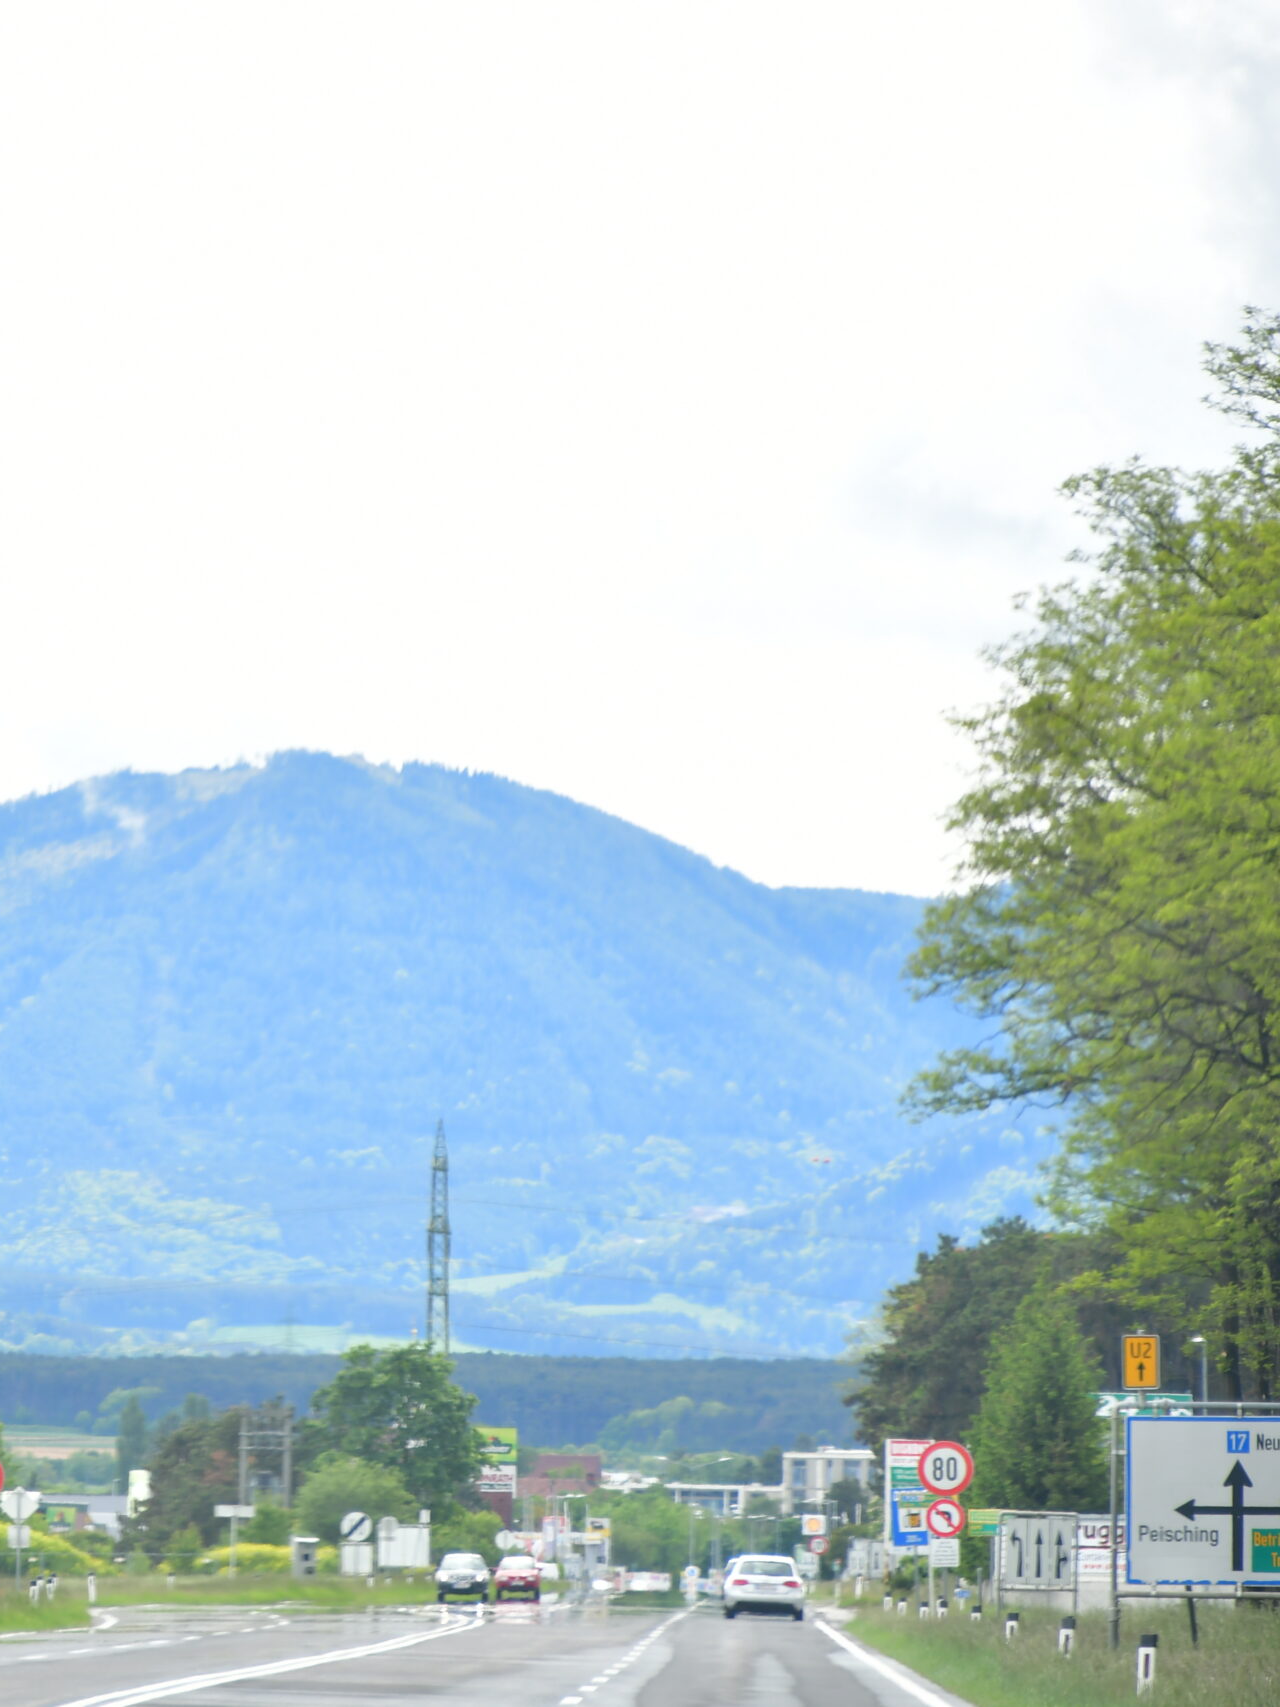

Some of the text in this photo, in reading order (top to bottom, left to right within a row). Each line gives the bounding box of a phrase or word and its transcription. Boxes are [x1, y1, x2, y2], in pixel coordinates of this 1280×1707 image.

[1130, 1342, 1152, 1359] U2
[1229, 1433, 1280, 1451] 17 Neu
[932, 1457, 958, 1481] 80
[1138, 1525, 1219, 1546] Peisching
